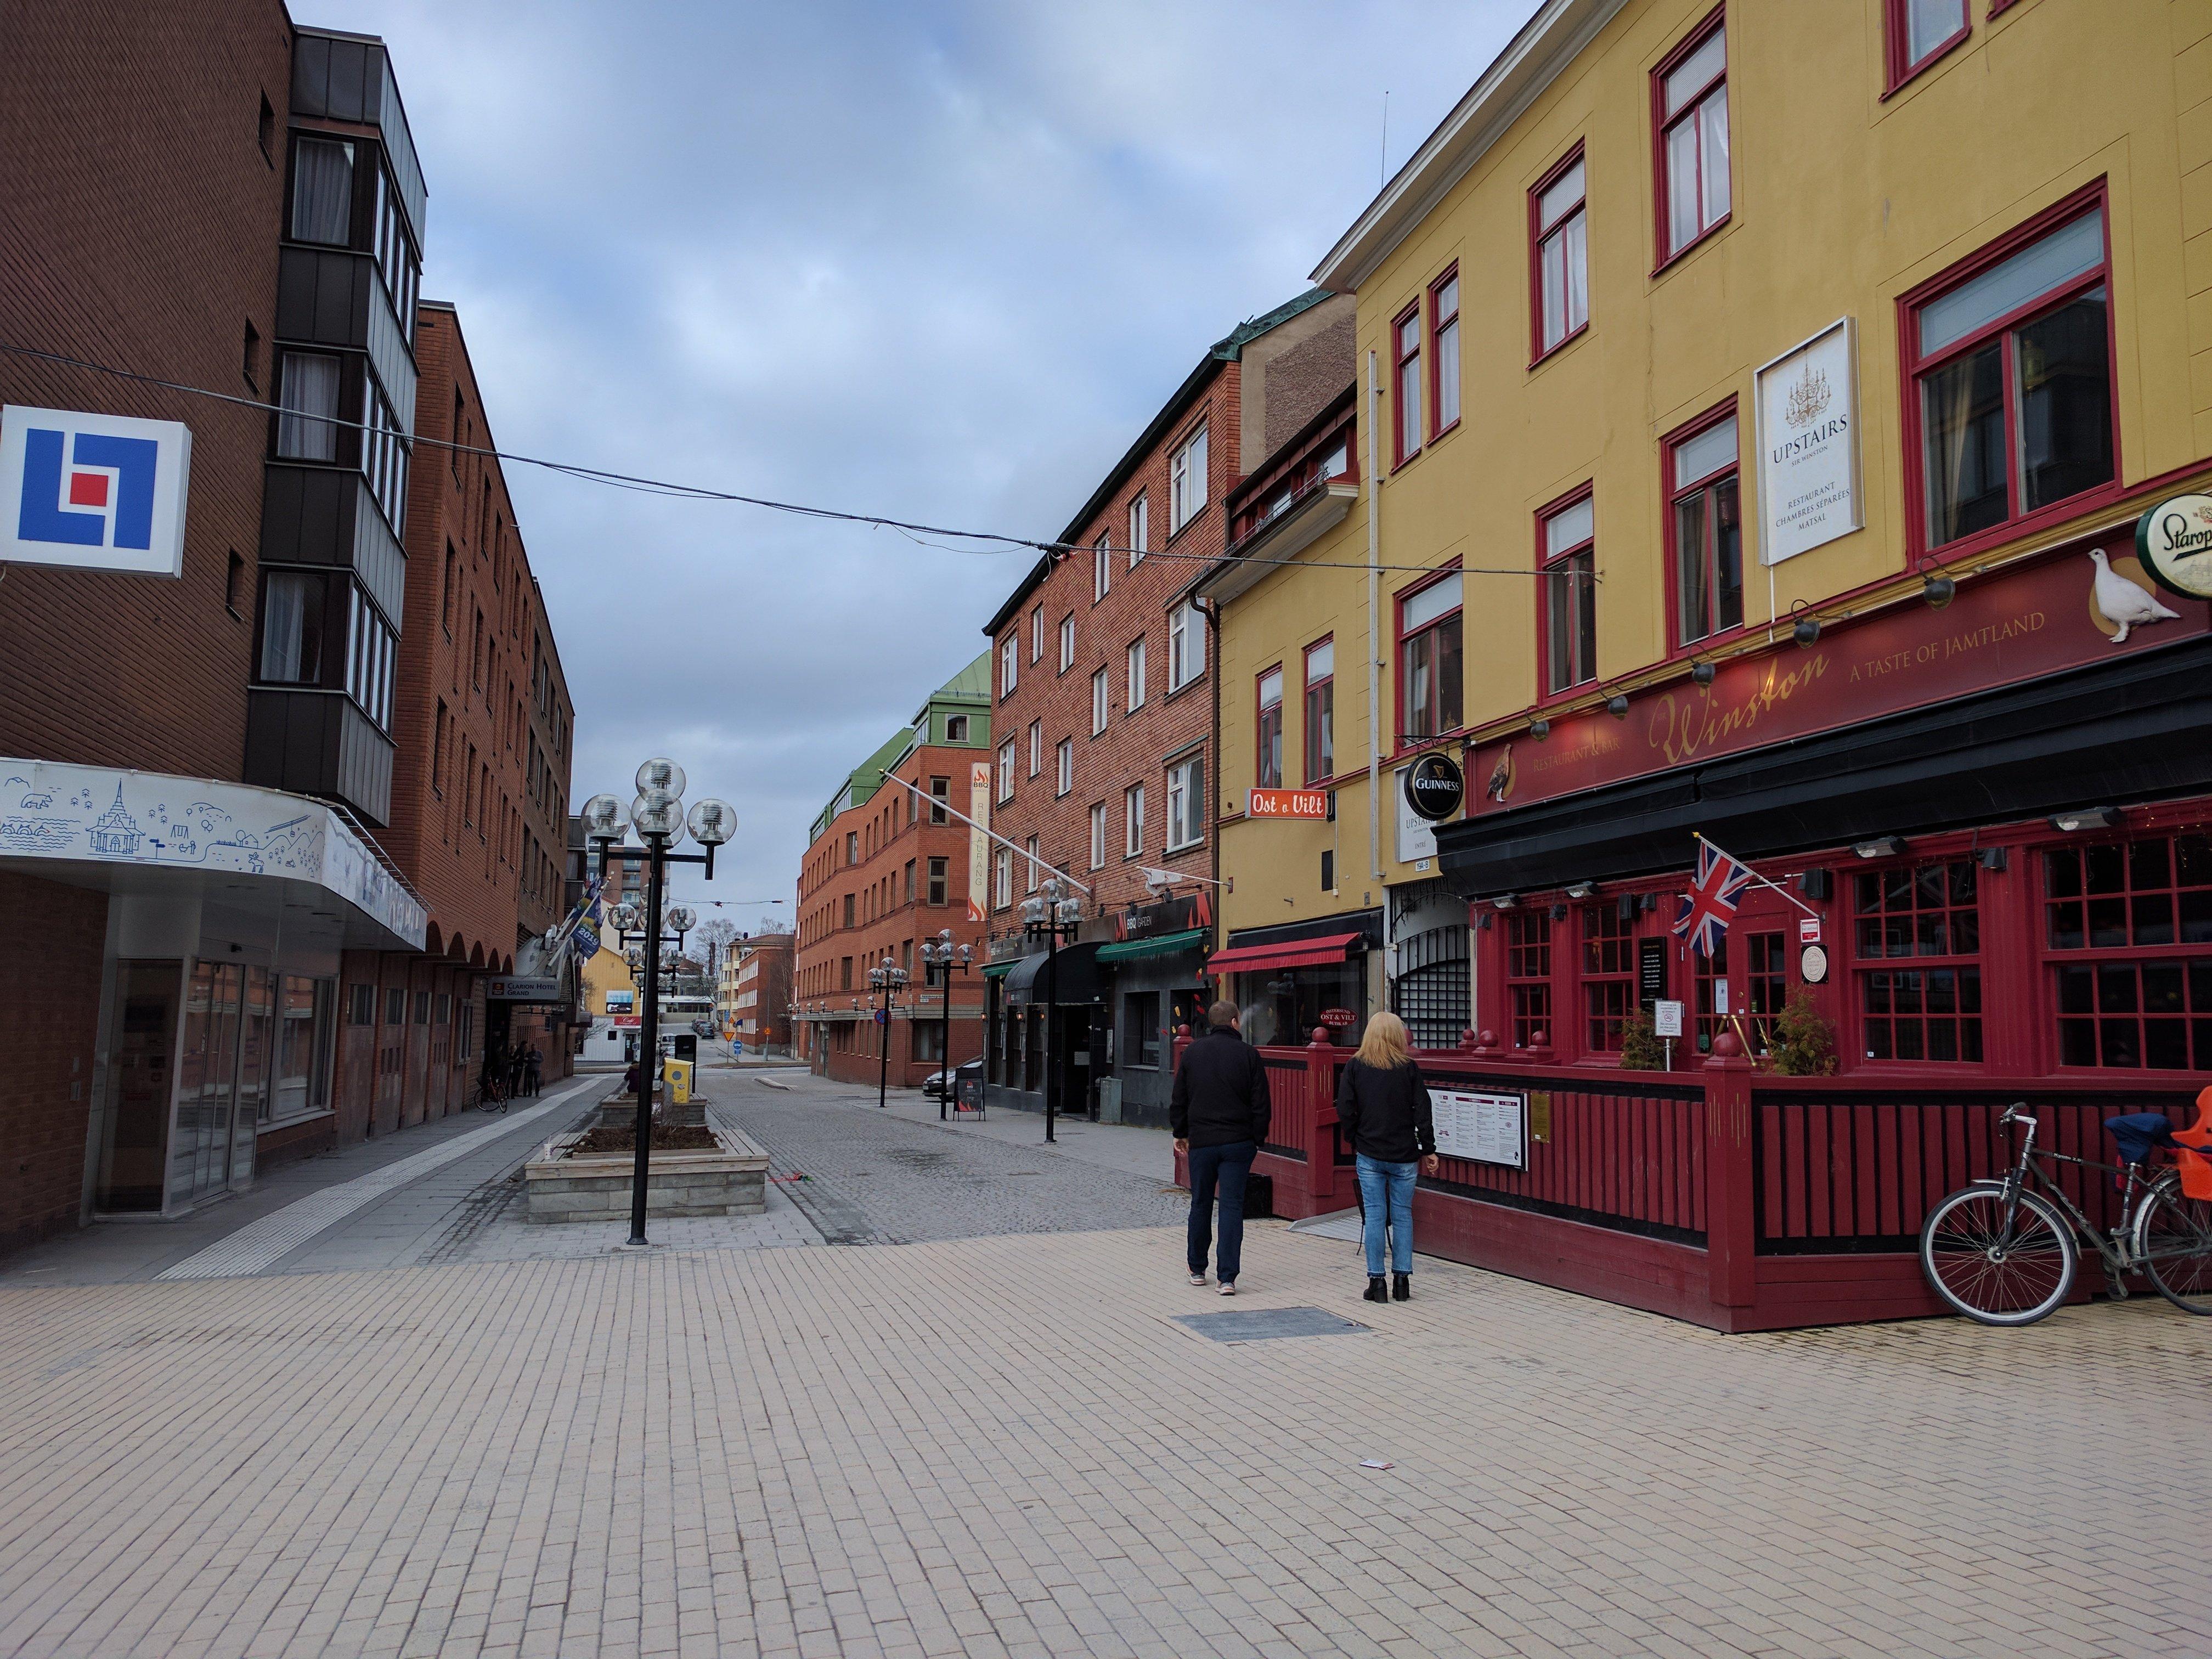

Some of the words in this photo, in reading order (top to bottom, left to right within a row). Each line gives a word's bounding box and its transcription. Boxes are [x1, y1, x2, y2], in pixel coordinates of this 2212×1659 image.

[1773, 414, 1847, 464] UPSTAIRS
[1791, 459, 1801, 467] SIR
[1802, 445, 1828, 461] WINSTON
[1788, 482, 1835, 509] RESTAURANT
[1776, 504, 1814, 528] CHAMBRES
[1816, 488, 1850, 510] SÉPARÉES
[1798, 512, 1827, 531] MATSAL
[1849, 665, 1861, 683] A
[1865, 651, 1910, 678] TASTE
[1916, 642, 1938, 663] OF
[1649, 653, 1830, 765] Winston
[1533, 745, 1589, 772] RESTAURANT
[1592, 740, 1599, 757] &
[1601, 737, 1620, 753] BAR
[1415, 777, 1459, 792] GUINNESS
[1252, 794, 1277, 812] Ost
[1282, 804, 1289, 813] o
[1293, 794, 1323, 814] Vilt
[1127, 917, 1136, 930] BBQ
[578, 928, 600, 946] 2019
